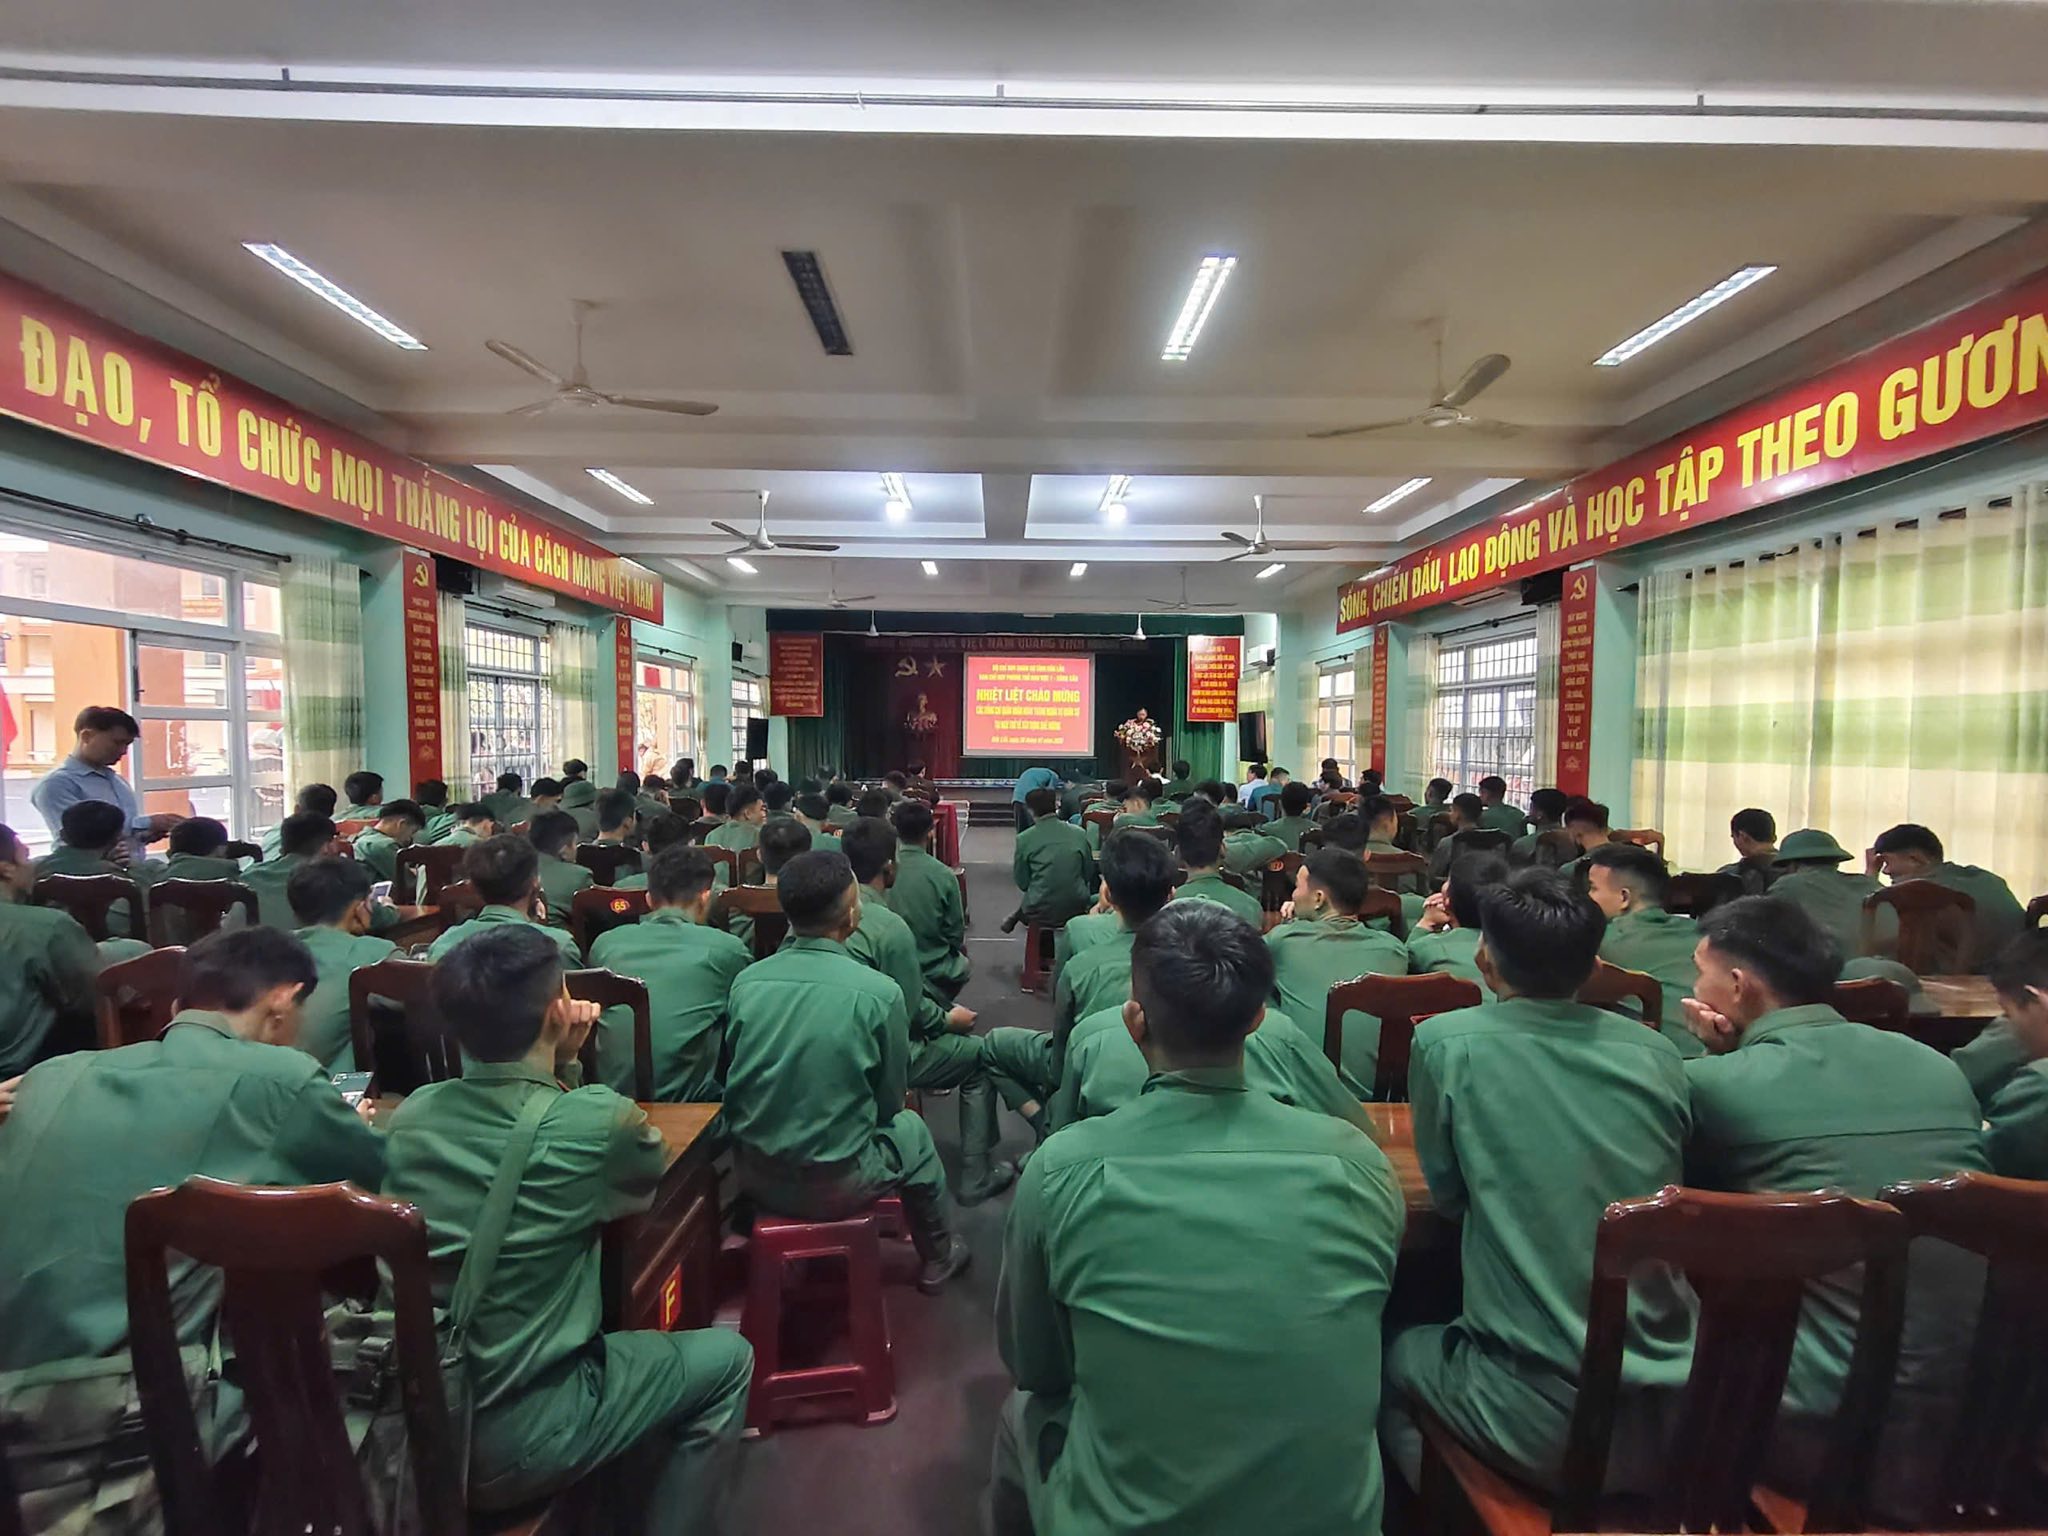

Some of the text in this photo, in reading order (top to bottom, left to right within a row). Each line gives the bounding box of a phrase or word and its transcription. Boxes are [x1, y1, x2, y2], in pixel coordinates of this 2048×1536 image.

[19, 315, 151, 443] ĐẠO,
[170, 373, 221, 457] TỔ
[237, 408, 321, 493] CHỨC
[331, 448, 384, 521] MỌI
[392, 471, 460, 543] THẮNG
[466, 505, 494, 560] LỢI
[499, 513, 530, 568] CỦA
[534, 532, 569, 581] CÁCH
[572, 551, 605, 596] MẠNG
[634, 578, 654, 612] NAM
[1412, 551, 1444, 598] ĐẤU,
[1449, 543, 1479, 587] LAO
[1484, 518, 1541, 578] ĐỘNG
[1548, 495, 1578, 553] VÀ
[1586, 477, 1645, 543] HỌC
[1656, 445, 1724, 522] TẬP
[1737, 391, 1859, 489] THEO
[976, 686, 1003, 704] NHIỆT
[1005, 686, 1024, 704] LIỆT
[1026, 687, 1050, 702] CHÀO
[665, 1280, 676, 1325] F
